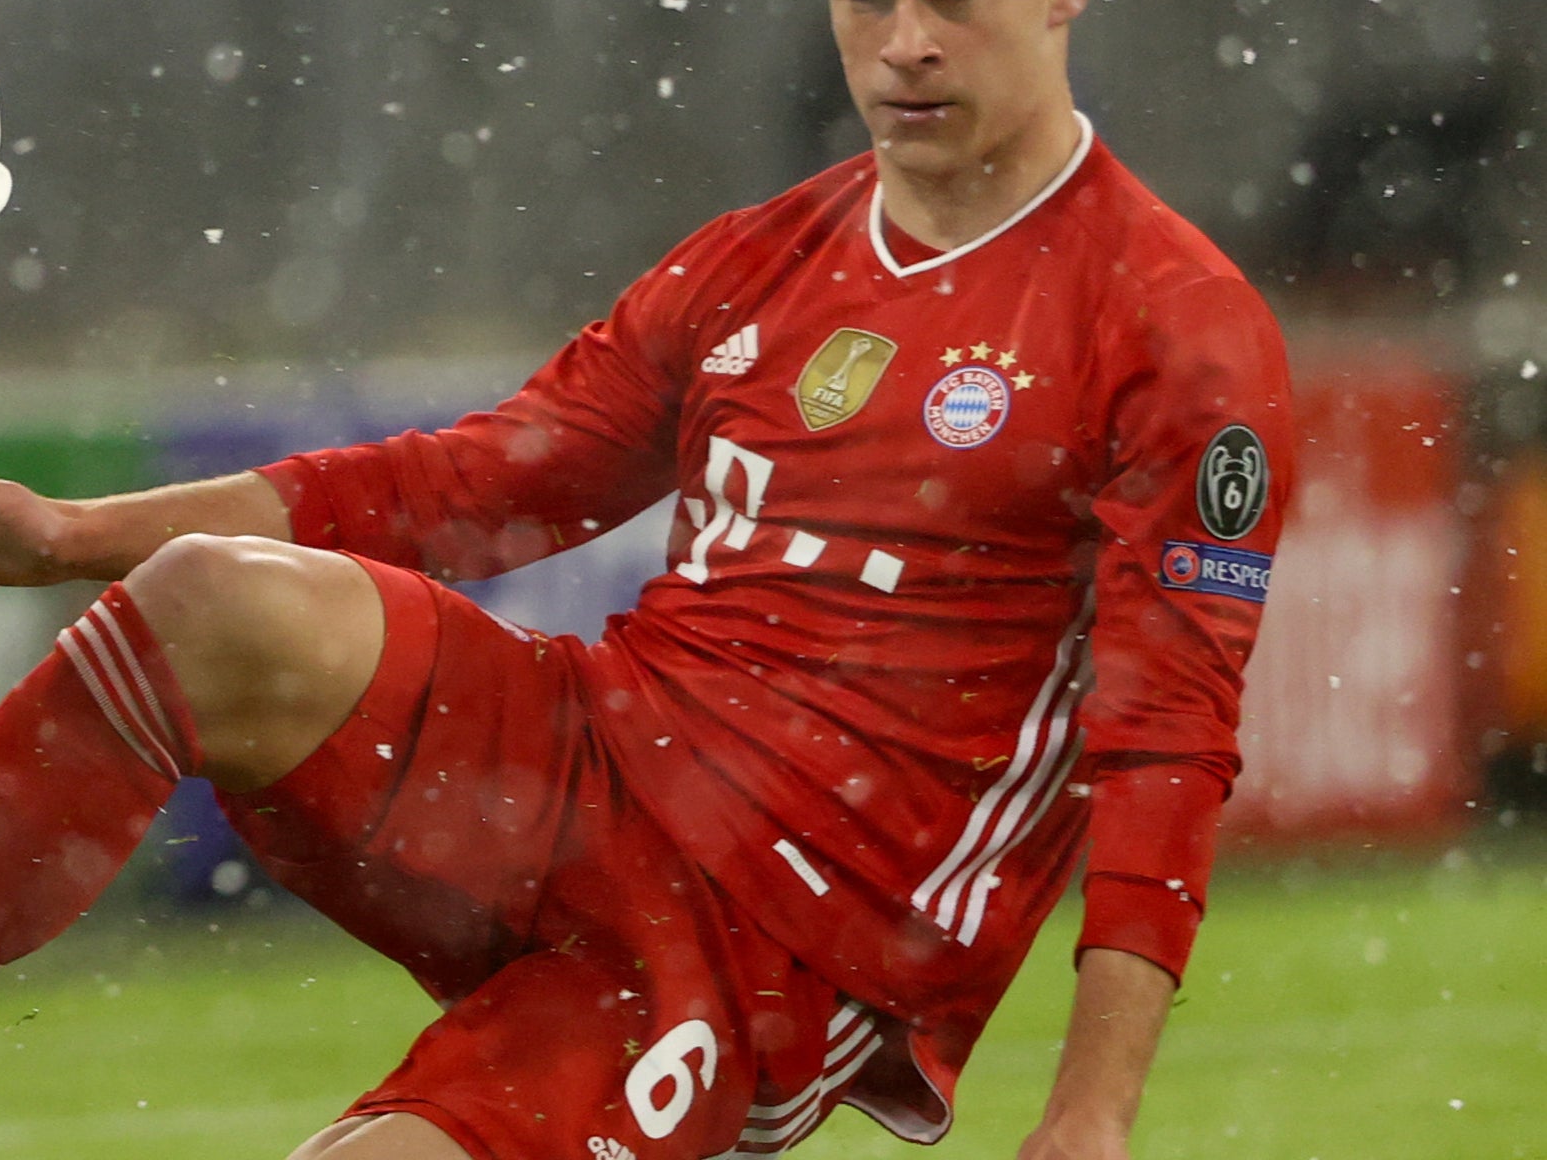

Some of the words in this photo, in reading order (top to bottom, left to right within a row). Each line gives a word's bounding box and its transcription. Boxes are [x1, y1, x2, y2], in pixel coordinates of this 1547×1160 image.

[812, 387, 845, 409] FIFA
[939, 376, 961, 394] FC
[962, 372, 1005, 411] BAYERN
[1224, 481, 1242, 509] 6
[624, 1019, 718, 1139] 6
